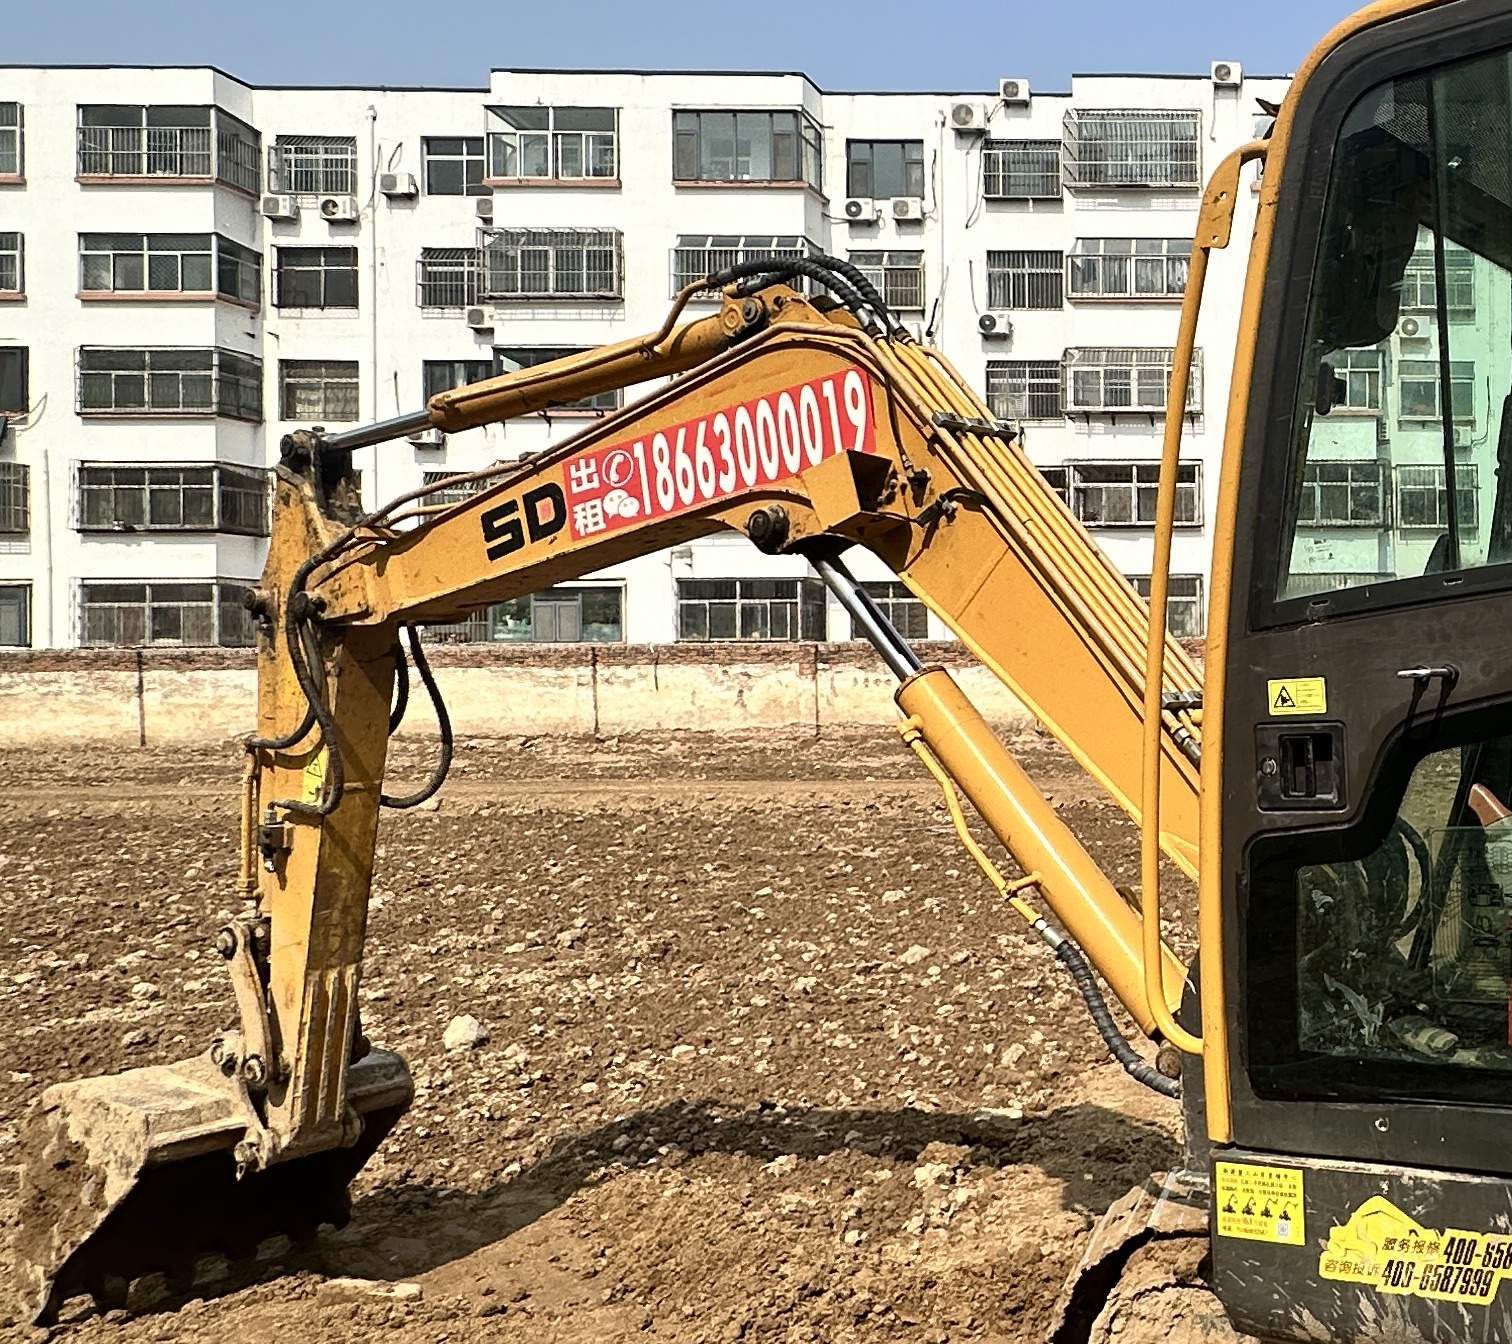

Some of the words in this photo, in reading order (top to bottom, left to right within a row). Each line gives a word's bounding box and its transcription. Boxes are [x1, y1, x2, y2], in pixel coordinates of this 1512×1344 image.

[632, 370, 867, 515] 18663000019
[480, 481, 567, 561] SD
[569, 457, 607, 537] 出租
